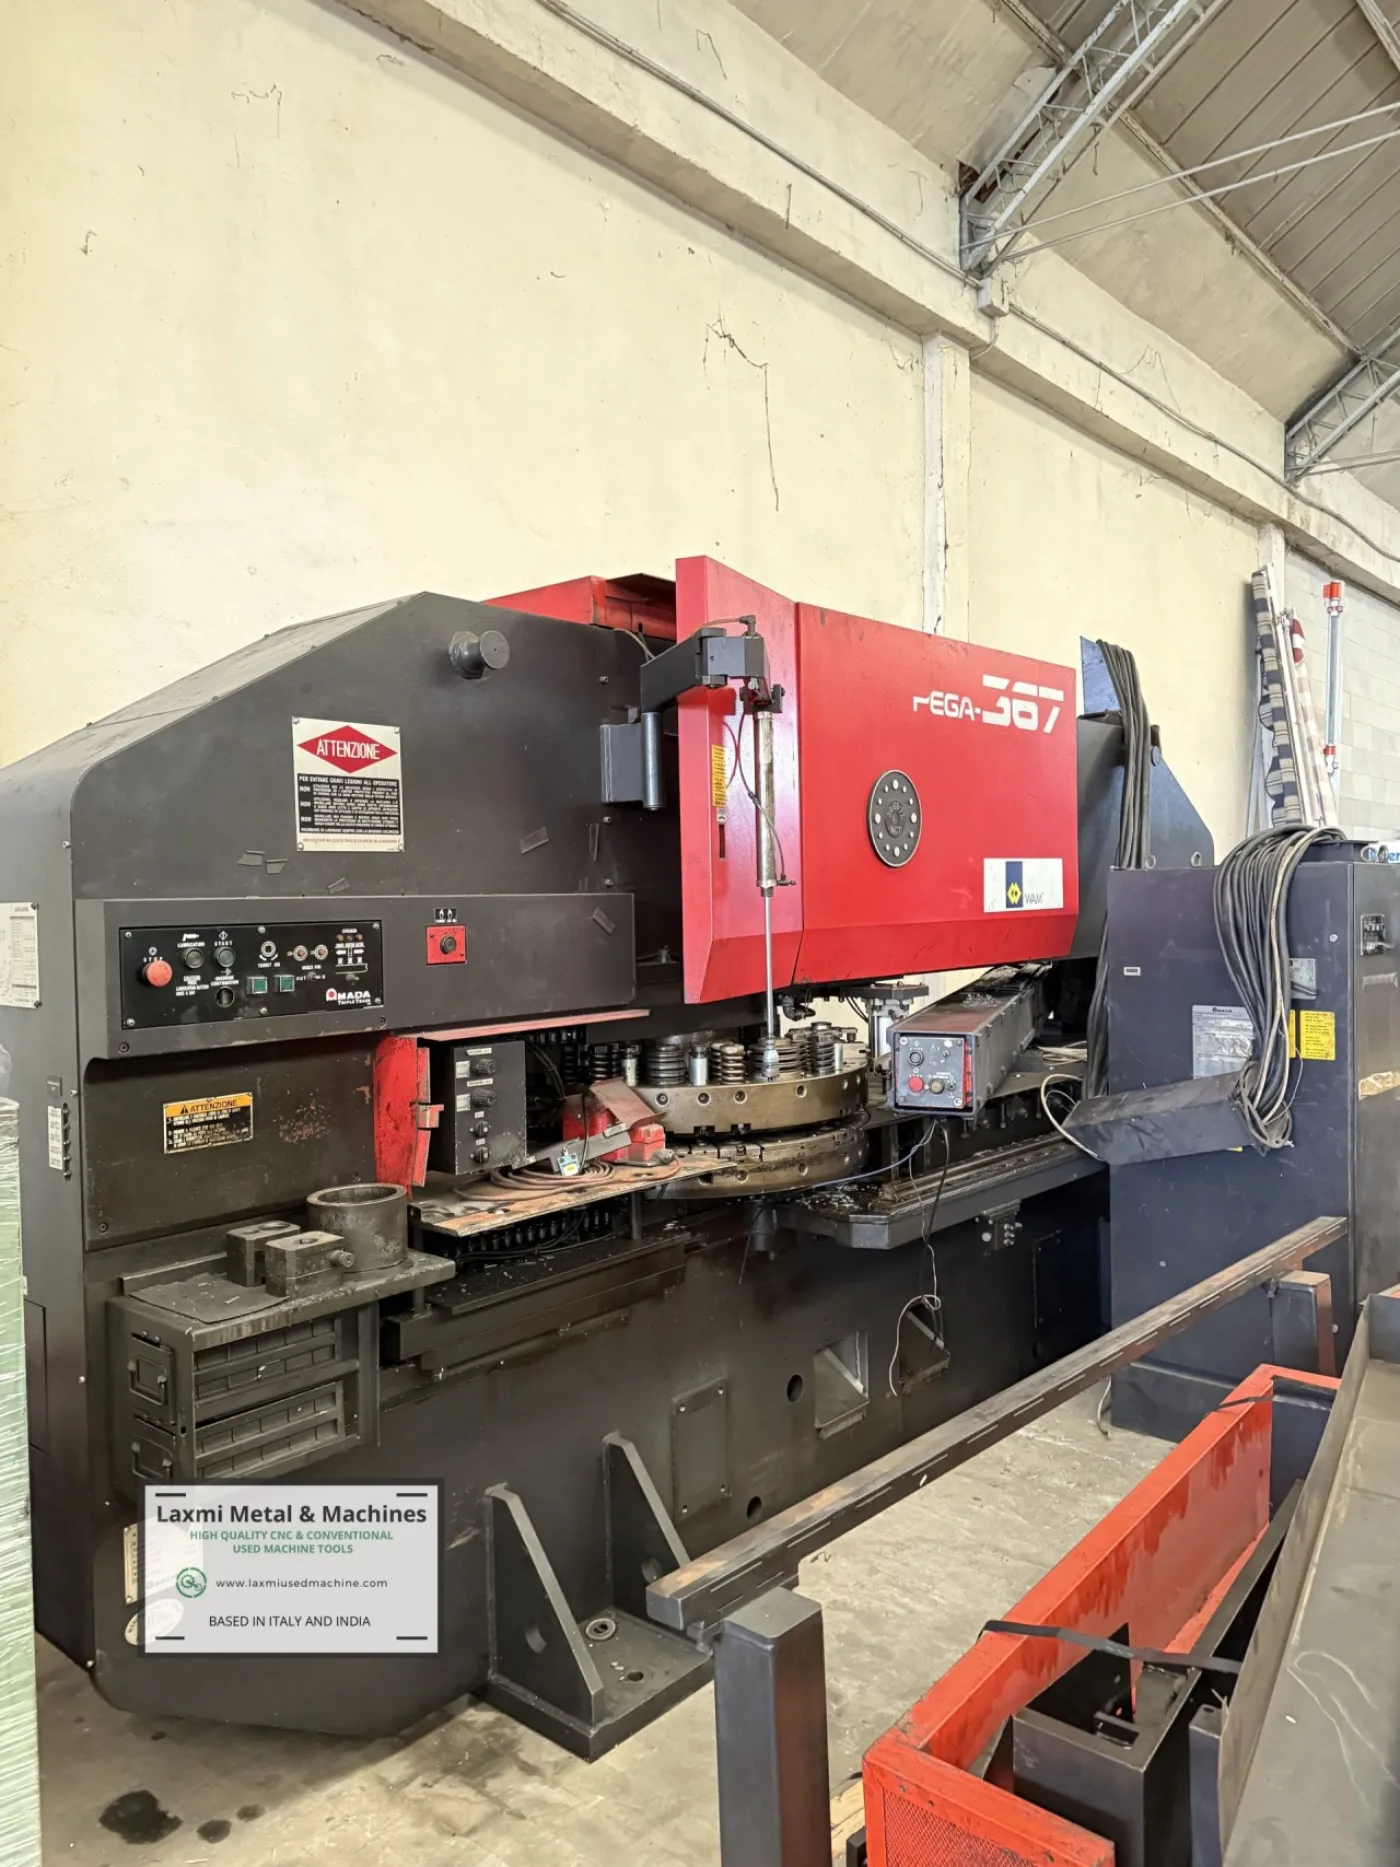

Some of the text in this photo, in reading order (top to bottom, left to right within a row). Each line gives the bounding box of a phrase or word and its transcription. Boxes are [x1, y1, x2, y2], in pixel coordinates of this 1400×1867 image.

[316, 739, 381, 760] ATTENZIONE
[326, 987, 371, 1002] AMADA
[190, 1099, 237, 1112] ATTENZIONE
